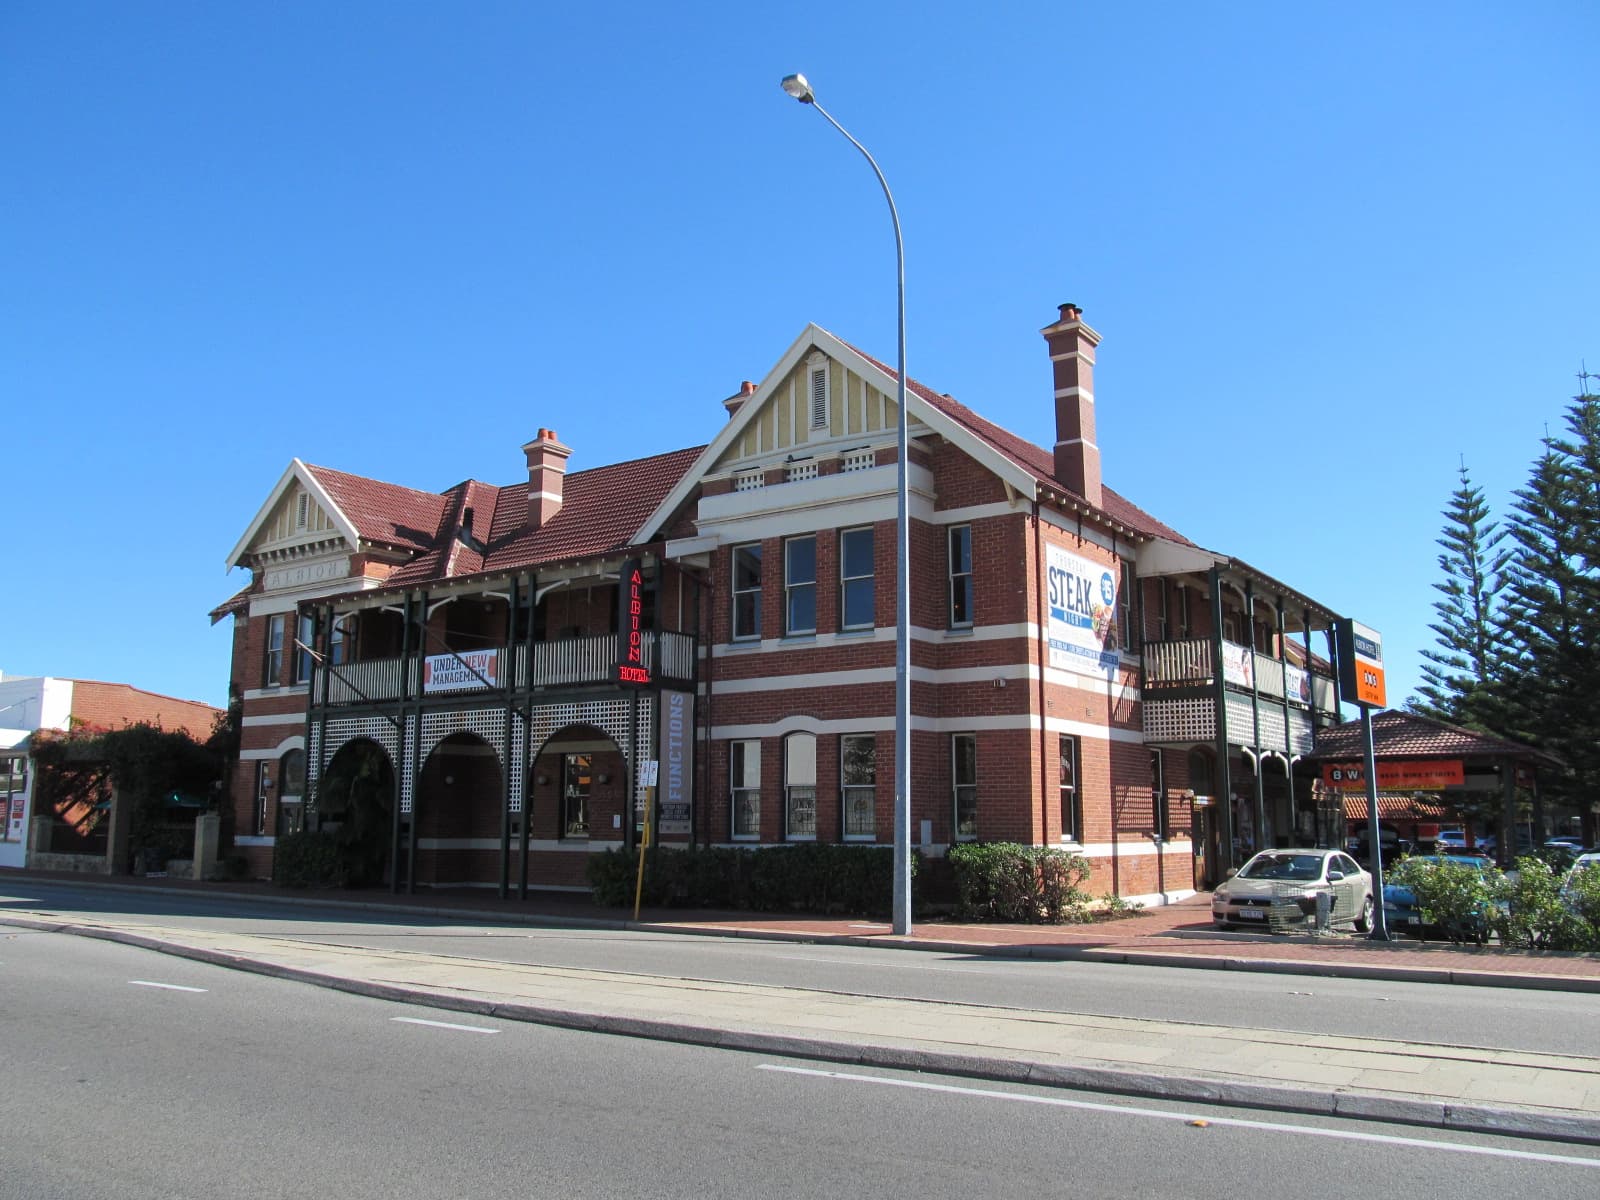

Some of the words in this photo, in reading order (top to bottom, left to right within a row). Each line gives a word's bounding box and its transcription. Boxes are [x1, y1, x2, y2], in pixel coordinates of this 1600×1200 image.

[629, 569, 641, 662] ALBION
[1049, 565, 1093, 617] STEAK
[433, 657, 462, 673] UNDER
[465, 654, 487, 669] NEW
[619, 666, 650, 683] HOTEL
[669, 694, 684, 800] FUNCTIONS
